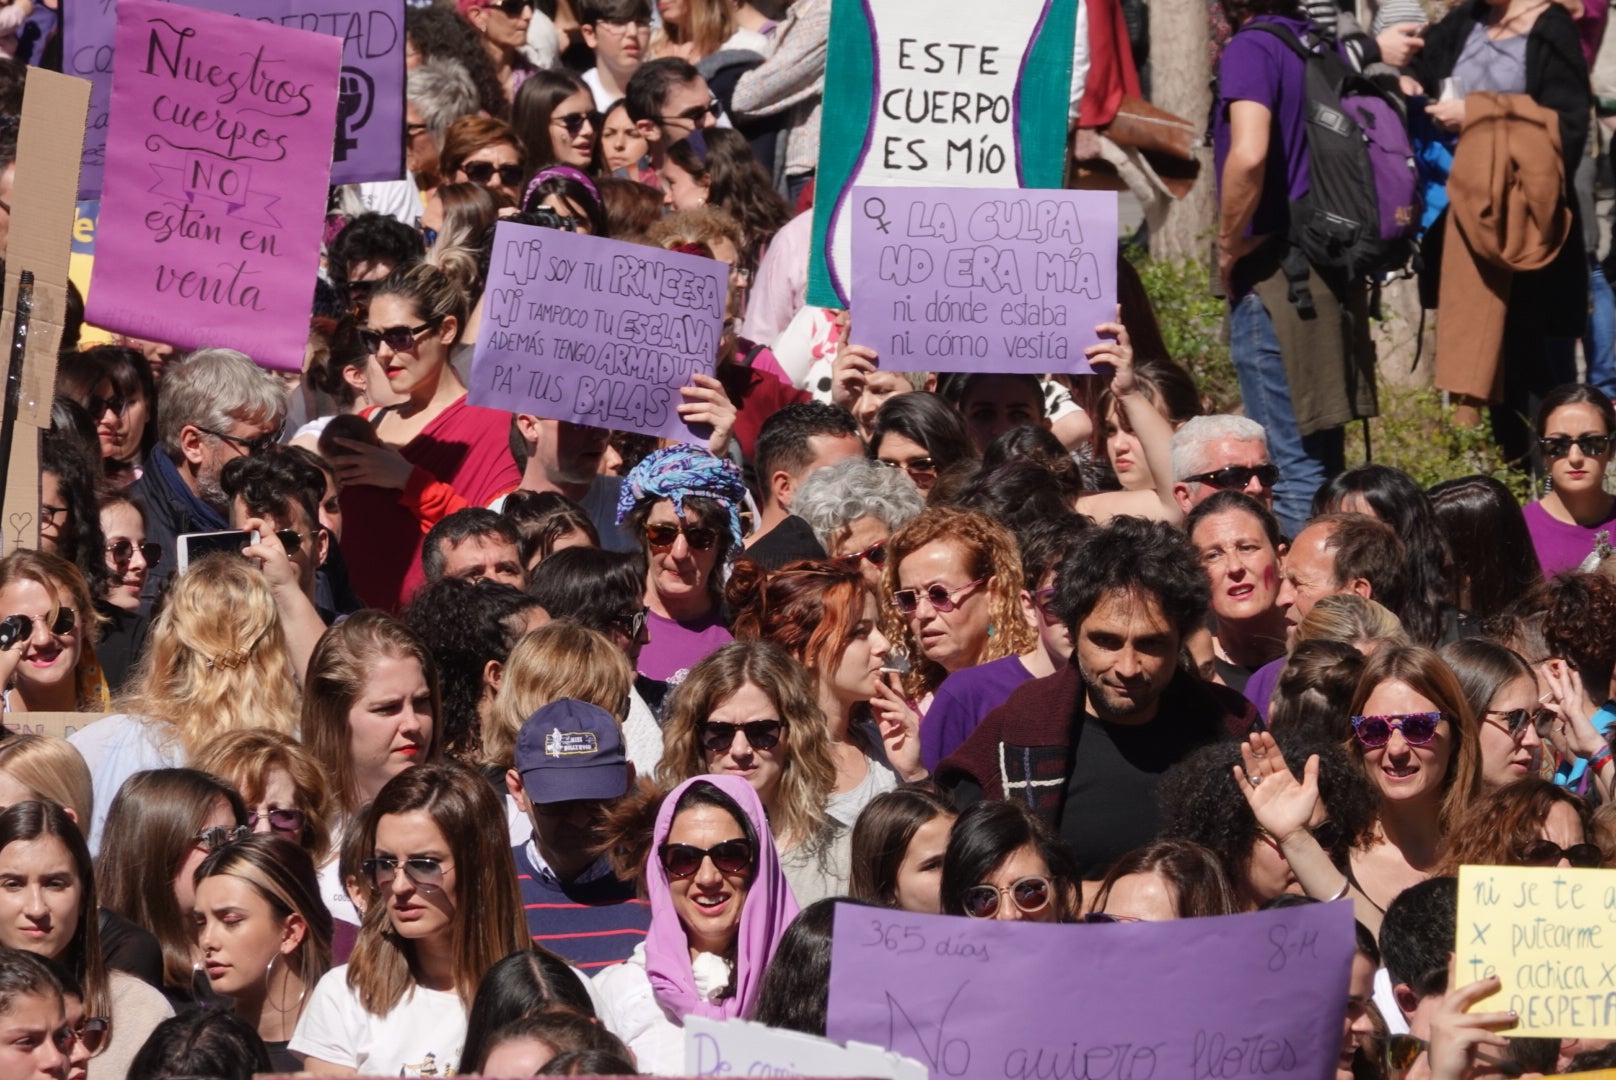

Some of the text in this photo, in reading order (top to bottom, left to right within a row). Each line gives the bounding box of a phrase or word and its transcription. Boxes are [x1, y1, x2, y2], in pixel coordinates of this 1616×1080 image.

[139, 18, 312, 117] Nuestros
[899, 38, 1000, 75] ESTE
[882, 87, 1011, 125] CUERPO
[145, 94, 287, 161] cuerpos
[883, 136, 928, 171] ES
[191, 159, 240, 197] NO
[144, 202, 283, 258] están en
[907, 198, 1084, 245] LA CULPA
[154, 259, 267, 313] venta
[544, 256, 579, 285] SOY
[583, 262, 604, 293] TU
[879, 244, 1102, 300] NO ERA MÍA
[893, 290, 1068, 327] ni dónde estaba
[486, 330, 545, 357] ADEMÁS
[553, 337, 596, 365] TENGO
[528, 302, 589, 329] TAMPOCO
[593, 309, 615, 336] TU
[616, 309, 714, 364] ESCLAVA
[891, 323, 1070, 361] ni cómo vestía
[528, 370, 565, 403] TUS
[573, 375, 671, 429] BALAS
[1473, 876, 1501, 907] ni
[1513, 881, 1540, 909] se
[1553, 874, 1585, 910] te
[861, 919, 991, 963] 365 días
[1511, 917, 1605, 957] putearme
[884, 978, 972, 1077] No
[1192, 1029, 1298, 1080] flores
